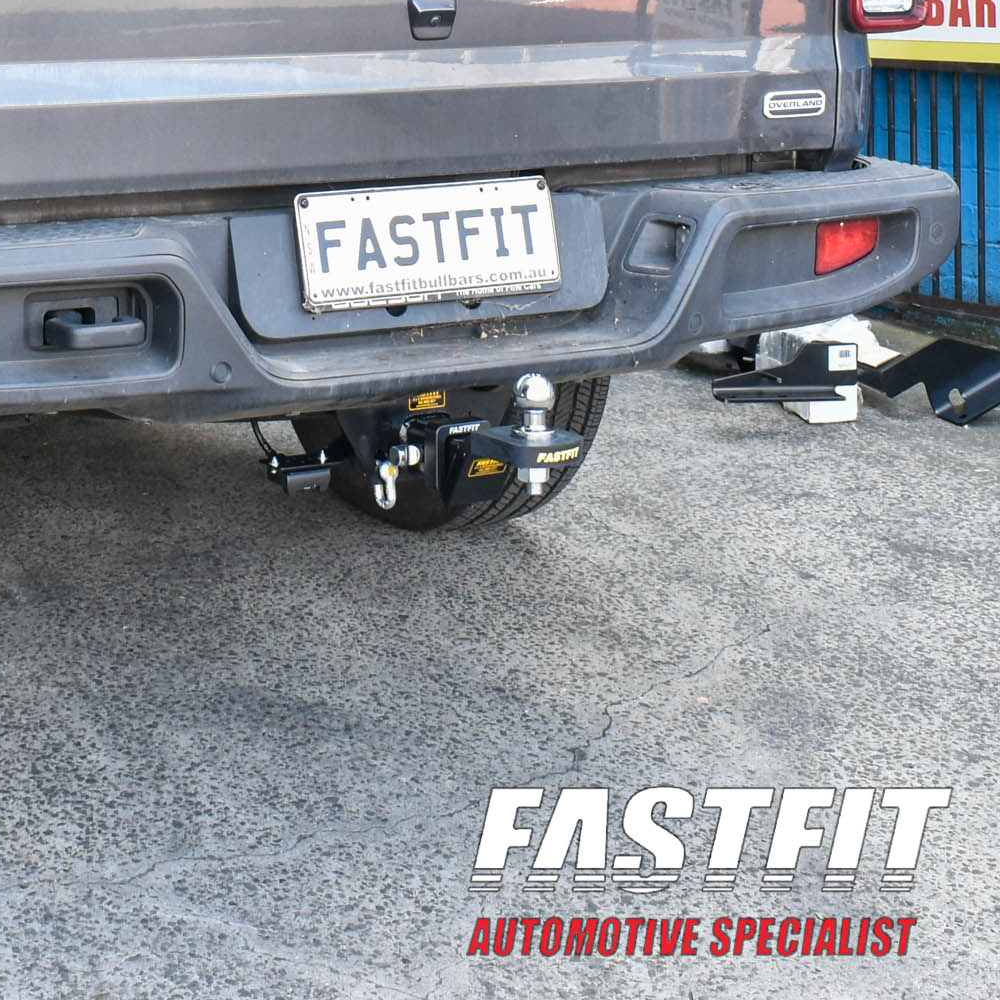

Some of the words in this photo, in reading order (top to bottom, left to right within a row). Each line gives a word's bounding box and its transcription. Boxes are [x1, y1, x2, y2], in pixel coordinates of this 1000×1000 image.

[768, 99, 823, 109] OVERLAND
[315, 204, 538, 274] FASTFIT
[321, 267, 547, 299] www.fastfitbullbars.com.au
[449, 423, 481, 435] FASTFIT
[536, 446, 580, 464] FASTFIT
